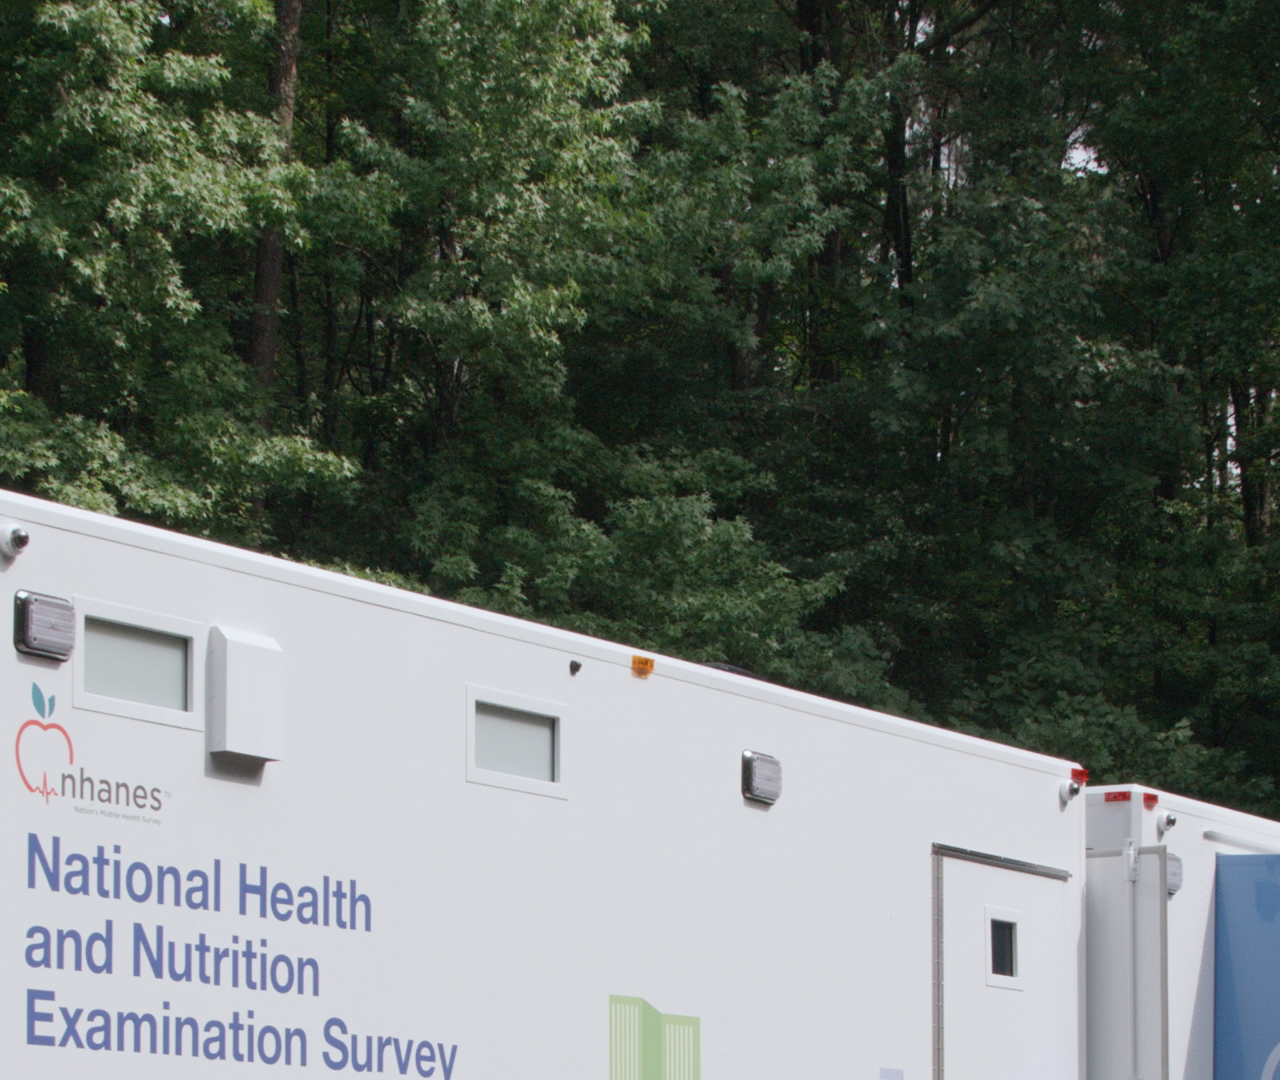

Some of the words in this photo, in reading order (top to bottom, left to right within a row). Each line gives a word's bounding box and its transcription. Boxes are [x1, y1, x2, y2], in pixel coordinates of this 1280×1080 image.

[61, 767, 162, 812] nhanes
[100, 810, 120, 819] Mobile
[121, 813, 141, 822] Health
[142, 816, 162, 826] Survey
[26, 831, 222, 913] National
[238, 862, 373, 932] Health
[23, 919, 113, 975] and
[131, 921, 320, 997] Nutrition
[25, 987, 308, 1067] Examination
